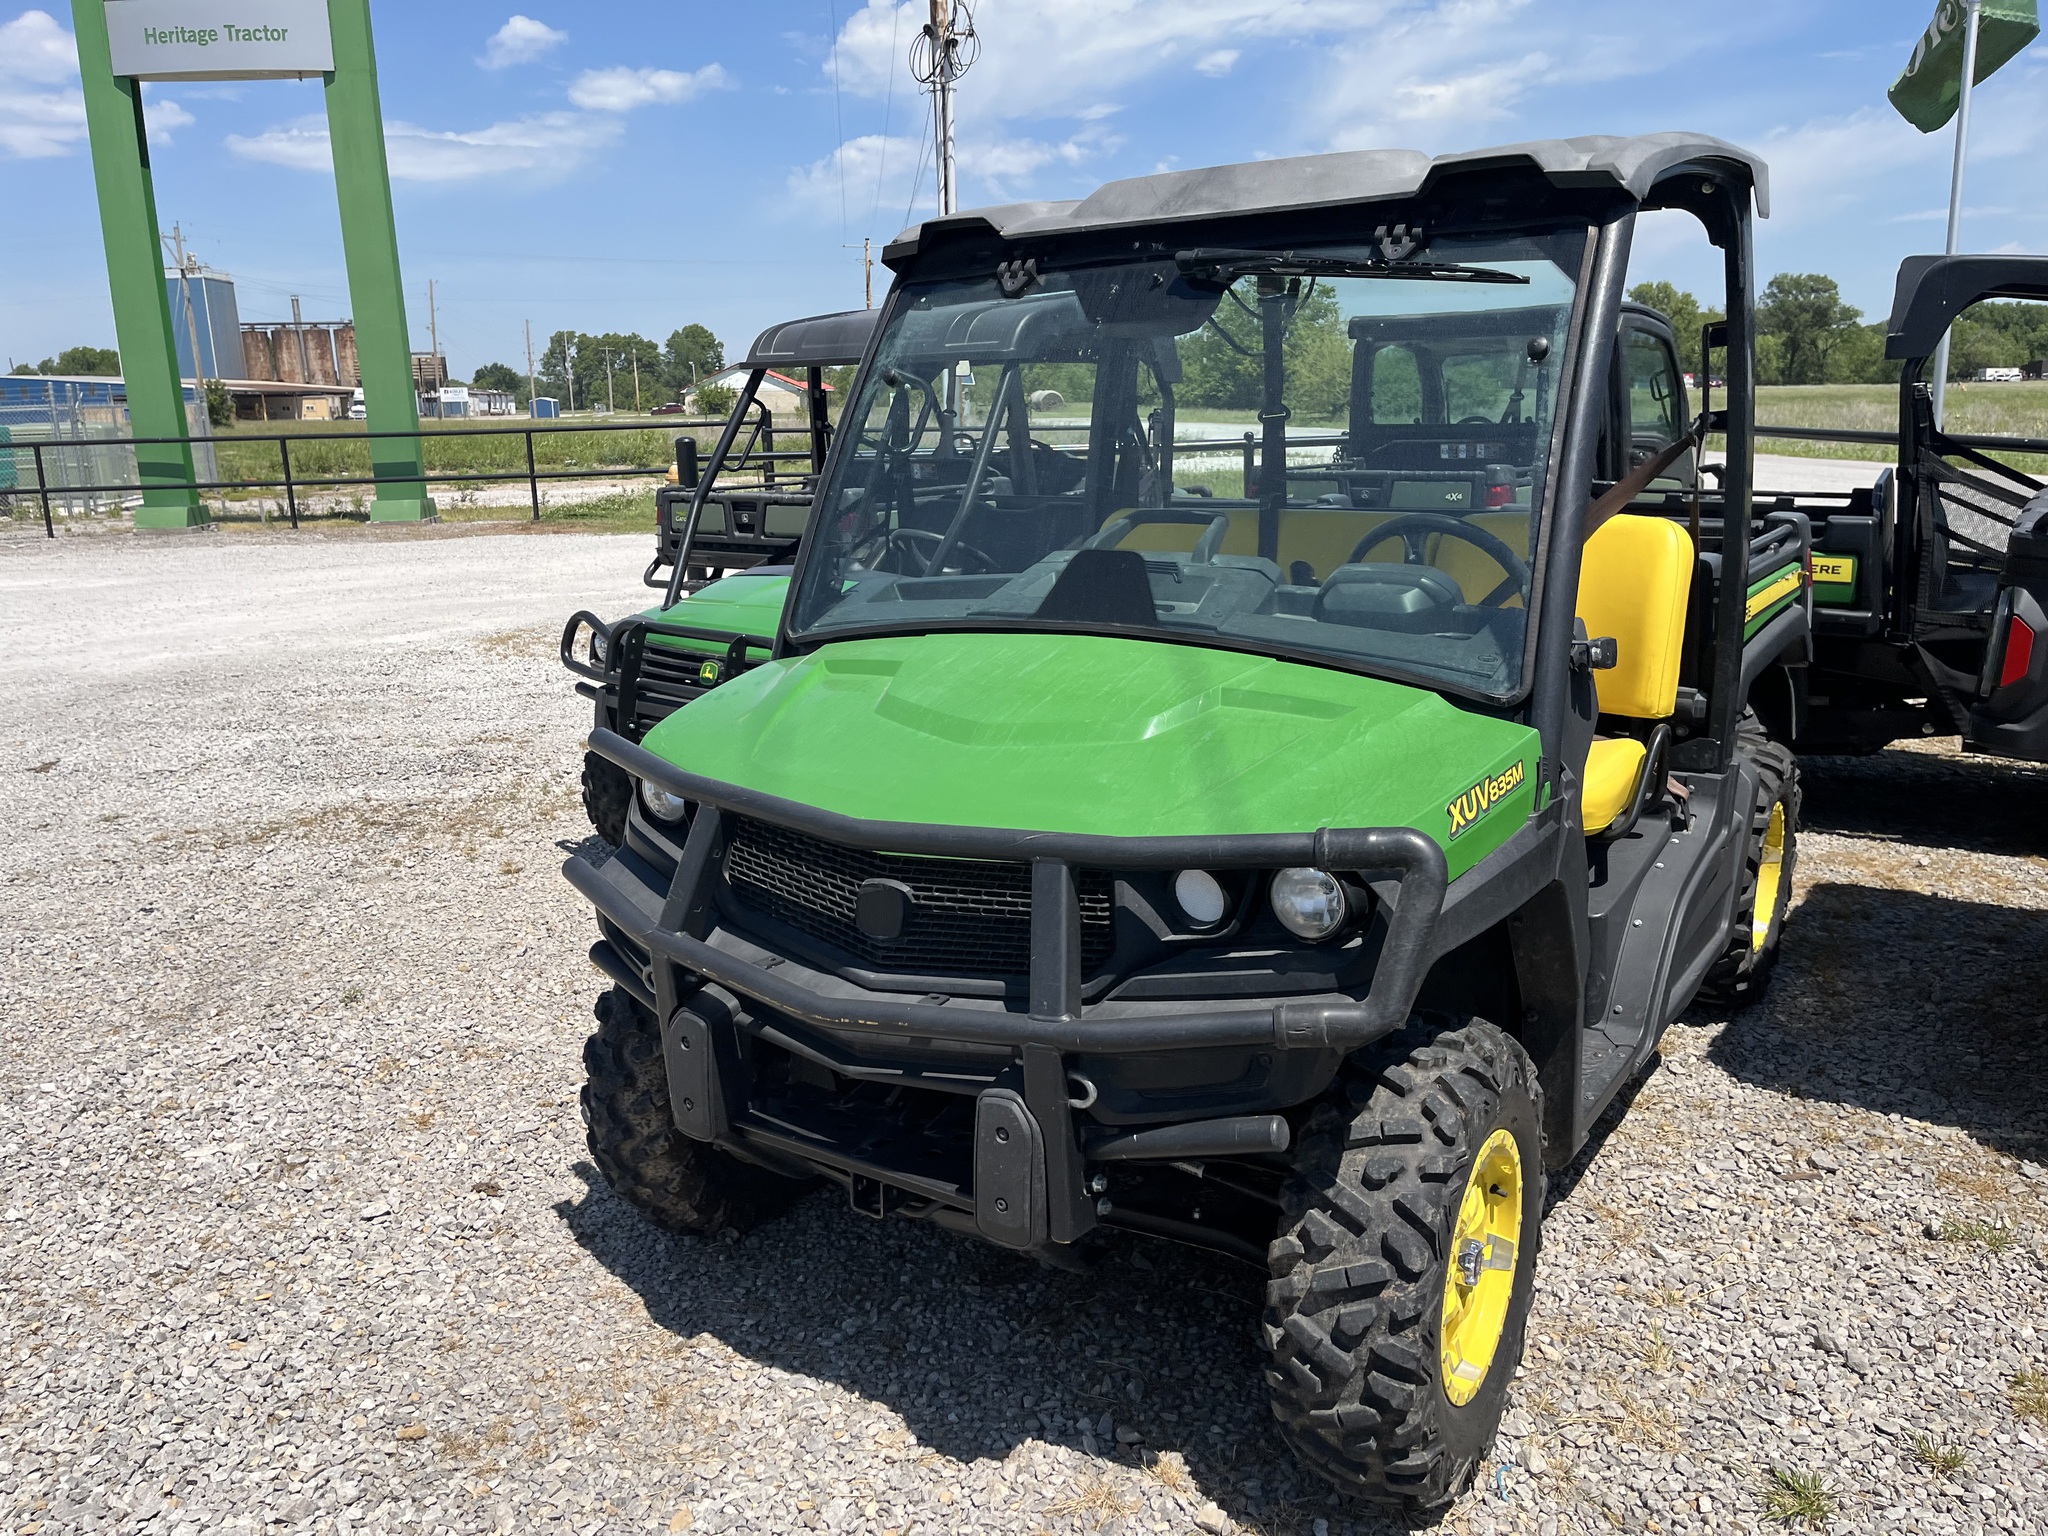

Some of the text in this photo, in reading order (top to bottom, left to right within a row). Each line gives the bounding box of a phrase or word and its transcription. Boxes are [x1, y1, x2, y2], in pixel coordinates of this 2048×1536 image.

[144, 24, 288, 46] Heritage Tractor
[1811, 564, 1842, 575] ERE
[1448, 760, 1524, 835] XUV835M
